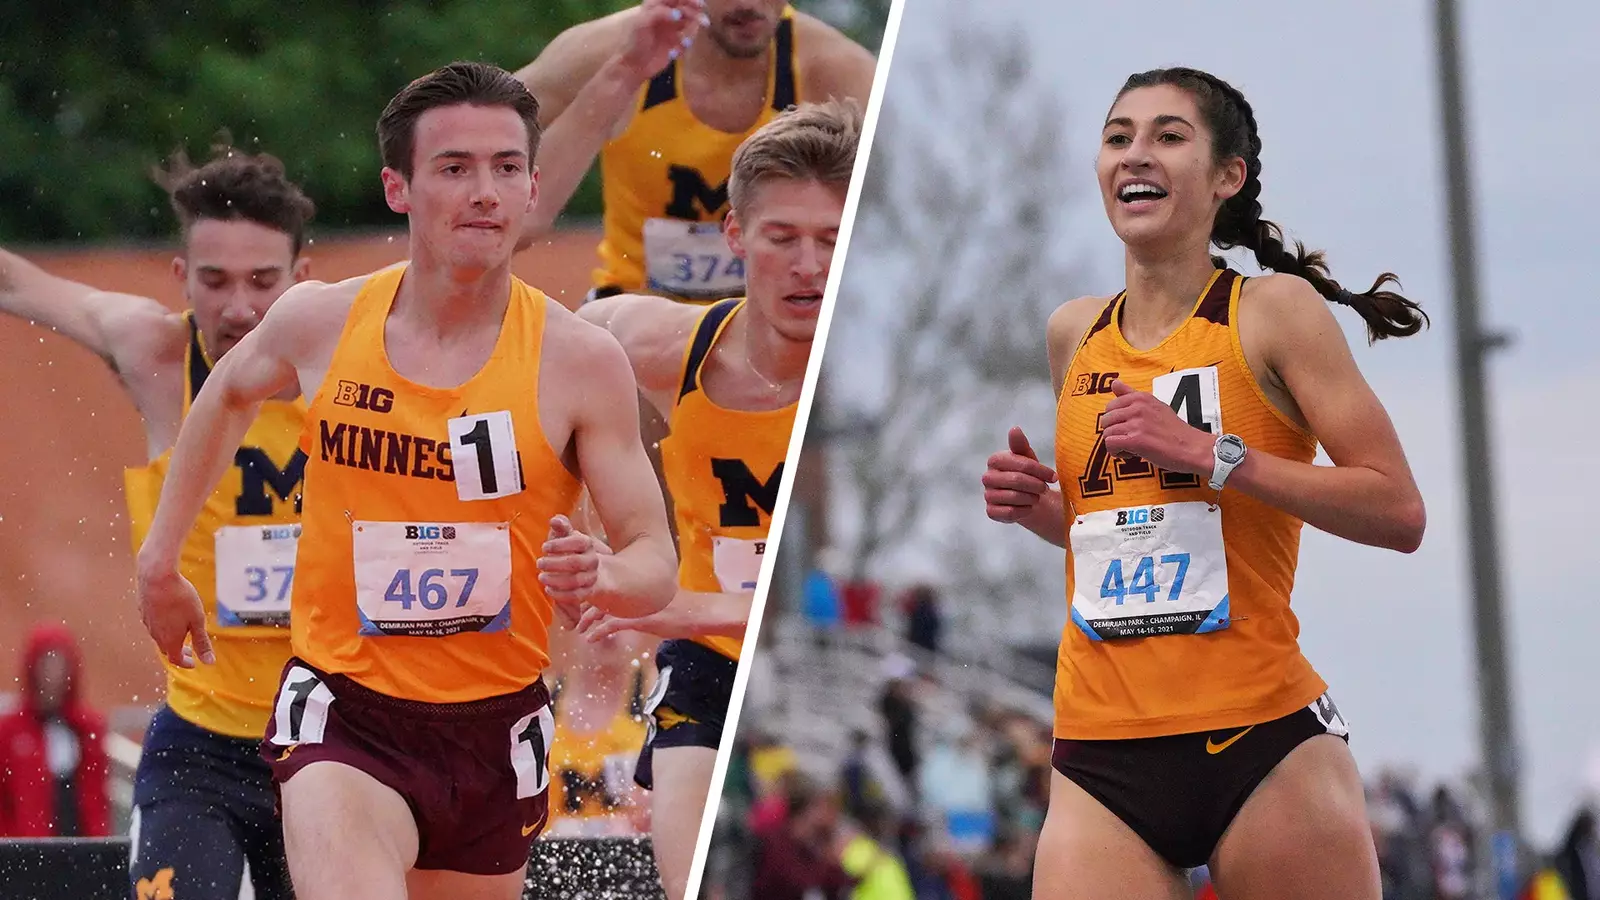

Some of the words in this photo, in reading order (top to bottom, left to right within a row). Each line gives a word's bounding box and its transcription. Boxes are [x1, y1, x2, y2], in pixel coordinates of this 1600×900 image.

[234, 446, 308, 516] M
[460, 419, 498, 494] 1
[711, 458, 786, 527] M
[244, 566, 293, 602] 37
[384, 568, 479, 610] 467
[1100, 553, 1190, 605] 447
[446, 626, 460, 634] 2021
[1093, 620, 1127, 629] DEMIRJIAN
[1128, 618, 1144, 626] PARK
[1150, 614, 1194, 624] CHAMPAIGN,
[288, 677, 320, 741] 1
[518, 716, 546, 789] 1
